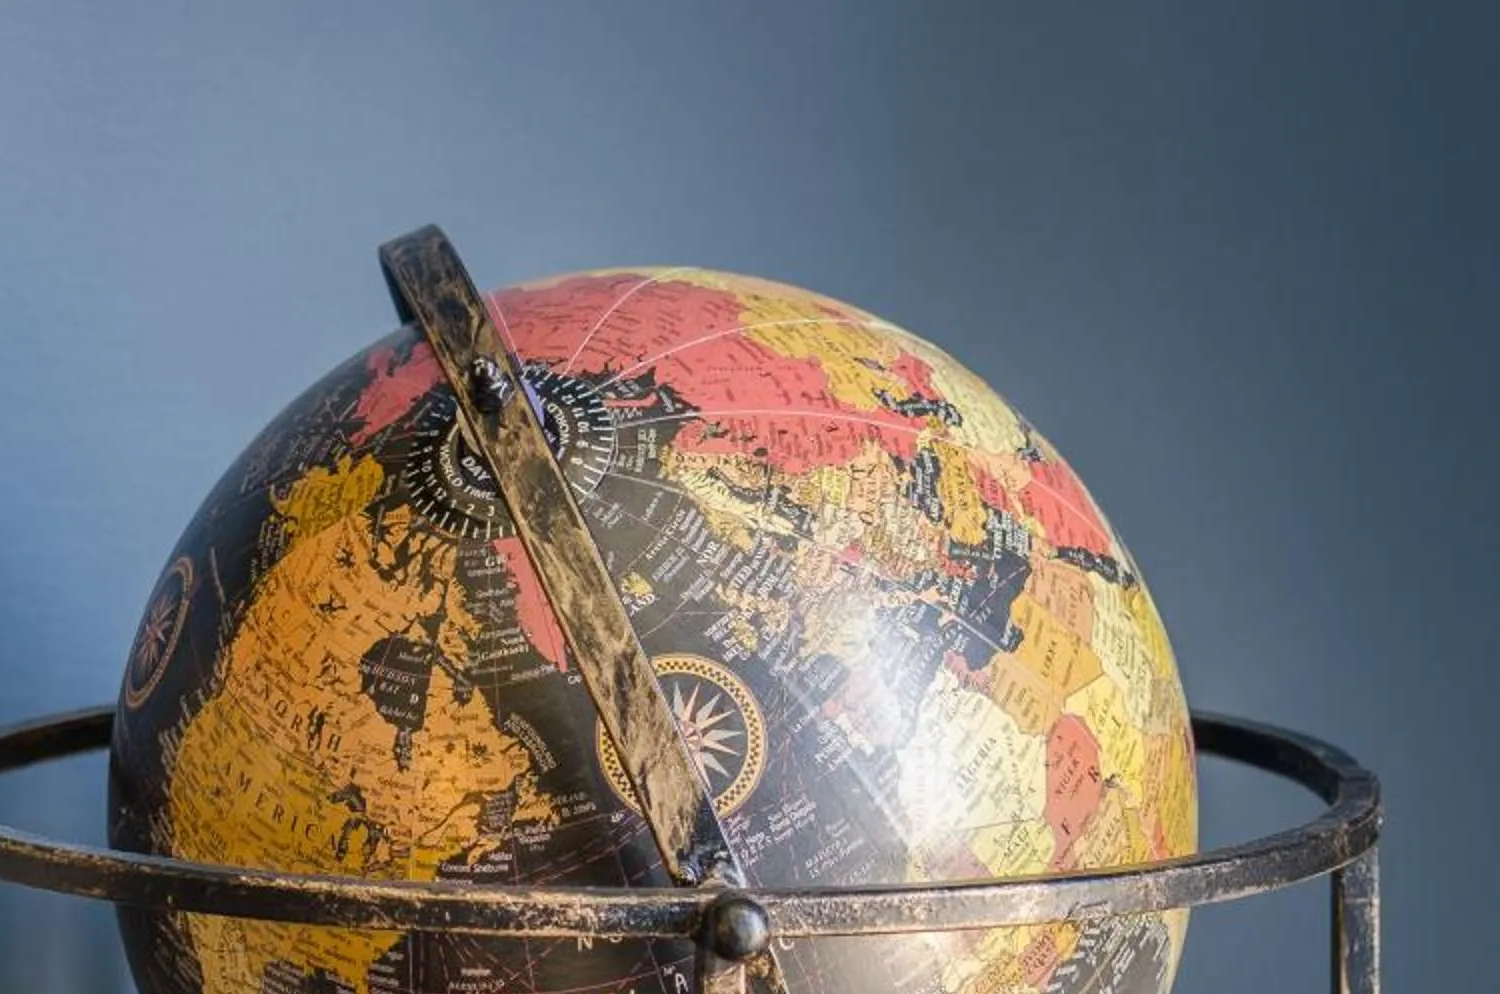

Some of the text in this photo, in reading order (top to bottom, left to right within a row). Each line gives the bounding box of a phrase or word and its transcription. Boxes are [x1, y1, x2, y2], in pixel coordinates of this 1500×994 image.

[439, 443, 463, 488] WORLD
[461, 456, 491, 482] DAY
[465, 503, 475, 515] 2
[487, 505, 496, 517] 3
